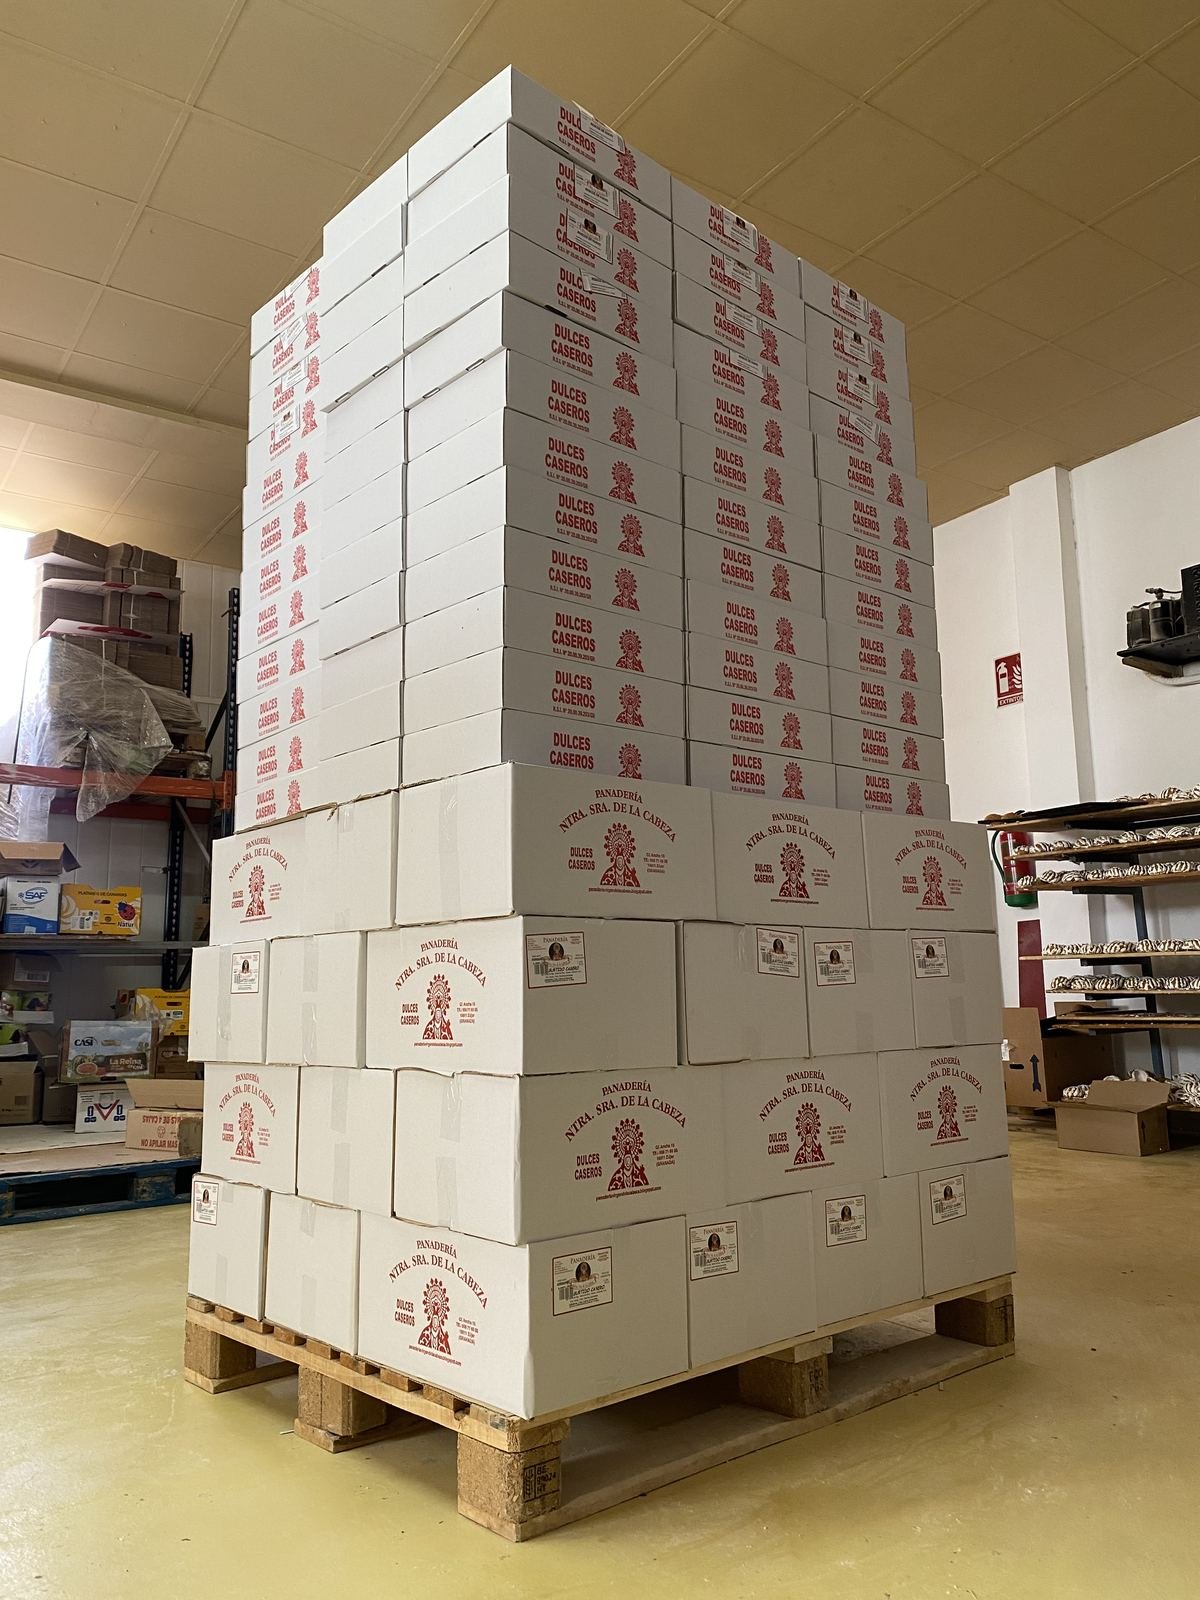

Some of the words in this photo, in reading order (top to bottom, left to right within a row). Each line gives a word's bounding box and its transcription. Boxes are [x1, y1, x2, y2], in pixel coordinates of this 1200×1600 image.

[558, 121, 596, 154] CASEROS
[710, 268, 740, 293] CASEROS
[557, 283, 596, 312] CASEROS
[274, 300, 295, 324] CASEROS
[555, 324, 590, 349] DULCES
[714, 316, 744, 340] CASEROS
[552, 340, 593, 367] CASEROS
[712, 364, 744, 387] CASEROS
[552, 380, 587, 404] DULCES
[548, 396, 590, 424] CASEROS
[717, 398, 744, 419] DULCES
[714, 413, 747, 435] CASEROS
[837, 427, 864, 447] CASEROS
[549, 438, 584, 461] DULCES
[716, 447, 743, 468] DULCES
[545, 454, 588, 479] CASEROS
[714, 462, 746, 483] CASEROS
[849, 456, 872, 474] DULCES
[264, 468, 282, 489] DULCES
[848, 469, 874, 488] CASEROS
[262, 480, 283, 503] CASEROS
[559, 493, 594, 516] DULCES
[718, 497, 746, 517] DULCES
[854, 500, 877, 517] DULCES
[261, 517, 280, 537] DULCES
[556, 510, 597, 534] CASEROS
[716, 513, 749, 533] CASEROS
[853, 514, 880, 532] CASEROS
[261, 529, 282, 550] CASEROS
[552, 550, 588, 572] DULCES
[723, 547, 752, 566] DULCES
[856, 545, 878, 561] DULCES
[261, 560, 279, 579] DULCES
[721, 562, 754, 583] CASEROS
[854, 558, 881, 576] CASEROS
[260, 572, 281, 593] CASEROS
[549, 567, 591, 590] CASEROS
[858, 591, 881, 607] DULCES
[258, 604, 277, 622] DULCES
[727, 602, 755, 620] DULCES
[856, 606, 883, 622] CASEROS
[257, 616, 278, 637] CASEROS
[556, 613, 592, 634] DULCES
[724, 618, 757, 637] CASEROS
[552, 630, 595, 652] CASEROS
[860, 637, 884, 653] DULCES
[258, 651, 277, 668] DULCES
[726, 650, 753, 667] DULCES
[859, 652, 886, 668] CASEROS
[257, 662, 279, 683] CASEROS
[556, 671, 592, 691] DULCES
[724, 666, 757, 683] CASEROS
[861, 681, 884, 697] DULCES
[260, 698, 278, 714] DULCES
[552, 688, 595, 709] CASEROS
[860, 696, 887, 712] CASEROS
[258, 711, 279, 729] CASEROS
[731, 703, 760, 719] DULCES
[730, 719, 763, 735] CASEROS
[863, 728, 886, 742] DULCES
[554, 733, 591, 751] DULCES
[861, 742, 888, 758] CASEROS
[258, 746, 275, 763] DULCES
[550, 751, 594, 769] CASEROS
[732, 754, 762, 769] DULCES
[257, 758, 277, 776] CASEROS
[730, 770, 765, 786] CASEROS
[866, 774, 890, 789] DULCES
[257, 789, 274, 805] DULCES
[595, 788, 642, 804] PANADERÍA
[864, 789, 892, 804] CASEROS
[256, 802, 276, 820] CASEROS
[772, 813, 809, 825] PANADERÍA
[559, 809, 588, 832] NTRA.
[589, 802, 611, 815] SRA.
[613, 802, 627, 814] DE
[629, 805, 641, 817] LA
[643, 810, 676, 842] CABEZA
[746, 830, 767, 851] NTRA.
[768, 824, 784, 836] SRA.
[786, 824, 797, 833] DE
[798, 826, 808, 837] LA
[809, 830, 836, 860] CABEZA
[914, 830, 945, 840] PANADERÍA
[570, 847, 593, 858] DULCES
[894, 846, 912, 866] NTRA.
[912, 840, 925, 851] SRA.
[926, 840, 935, 848] DE
[936, 841, 944, 850] LA
[945, 844, 967, 870] CABEZA
[568, 859, 595, 871] CASEROS
[755, 863, 772, 873] DULCES
[754, 874, 774, 884] CASEROS
[902, 876, 917, 884] DULCES
[25, 891, 47, 900] SAF
[902, 885, 919, 894] CASEROS
[420, 937, 458, 952] PANADERÍA
[394, 966, 416, 991] NTRA.
[416, 956, 433, 970] SRA.
[434, 952, 446, 963] DE
[447, 953, 457, 964] LA
[458, 956, 488, 988] CABEZA
[402, 1003, 418, 1013] DULCES
[400, 1015, 419, 1025] CASEROS
[74, 1038, 94, 1046] CASI
[930, 1056, 961, 1068] PANADERÍA
[786, 1068, 825, 1083] PANADERÍA
[909, 1079, 926, 1102] NTRA.
[927, 1070, 941, 1083] SRA.
[941, 1067, 950, 1077] DE
[951, 1068, 960, 1077] LA
[960, 1070, 983, 1094] CABEZA
[602, 1080, 651, 1096] PANADERÍA
[759, 1099, 782, 1122] NTRA.
[782, 1085, 800, 1100] SRA.
[801, 1082, 813, 1093] DE
[814, 1083, 824, 1093] LA
[825, 1086, 852, 1112] CABEZA
[565, 1112, 595, 1142] NTRA.
[596, 1099, 618, 1116] SRA.
[621, 1095, 635, 1107] DE
[638, 1096, 650, 1107] LA
[652, 1098, 687, 1128] CABEZA
[918, 1110, 932, 1120] DULCES
[917, 1120, 933, 1131] CASEROS
[149, 1140, 166, 1148] APILAR
[167, 1140, 178, 1148] MAS
[769, 1132, 787, 1143] DULCES
[768, 1143, 789, 1155] CASEROS
[577, 1153, 600, 1166] DULCES
[575, 1166, 602, 1180] CASEROS
[416, 1240, 457, 1259] PANADERÍA
[389, 1260, 411, 1283] NTRA.
[411, 1254, 429, 1266] SRA.
[431, 1254, 443, 1268] DE
[445, 1259, 456, 1274] LA
[457, 1267, 488, 1309] CABEZA
[396, 1299, 414, 1313] DULCES
[395, 1311, 415, 1327] CASEROS
